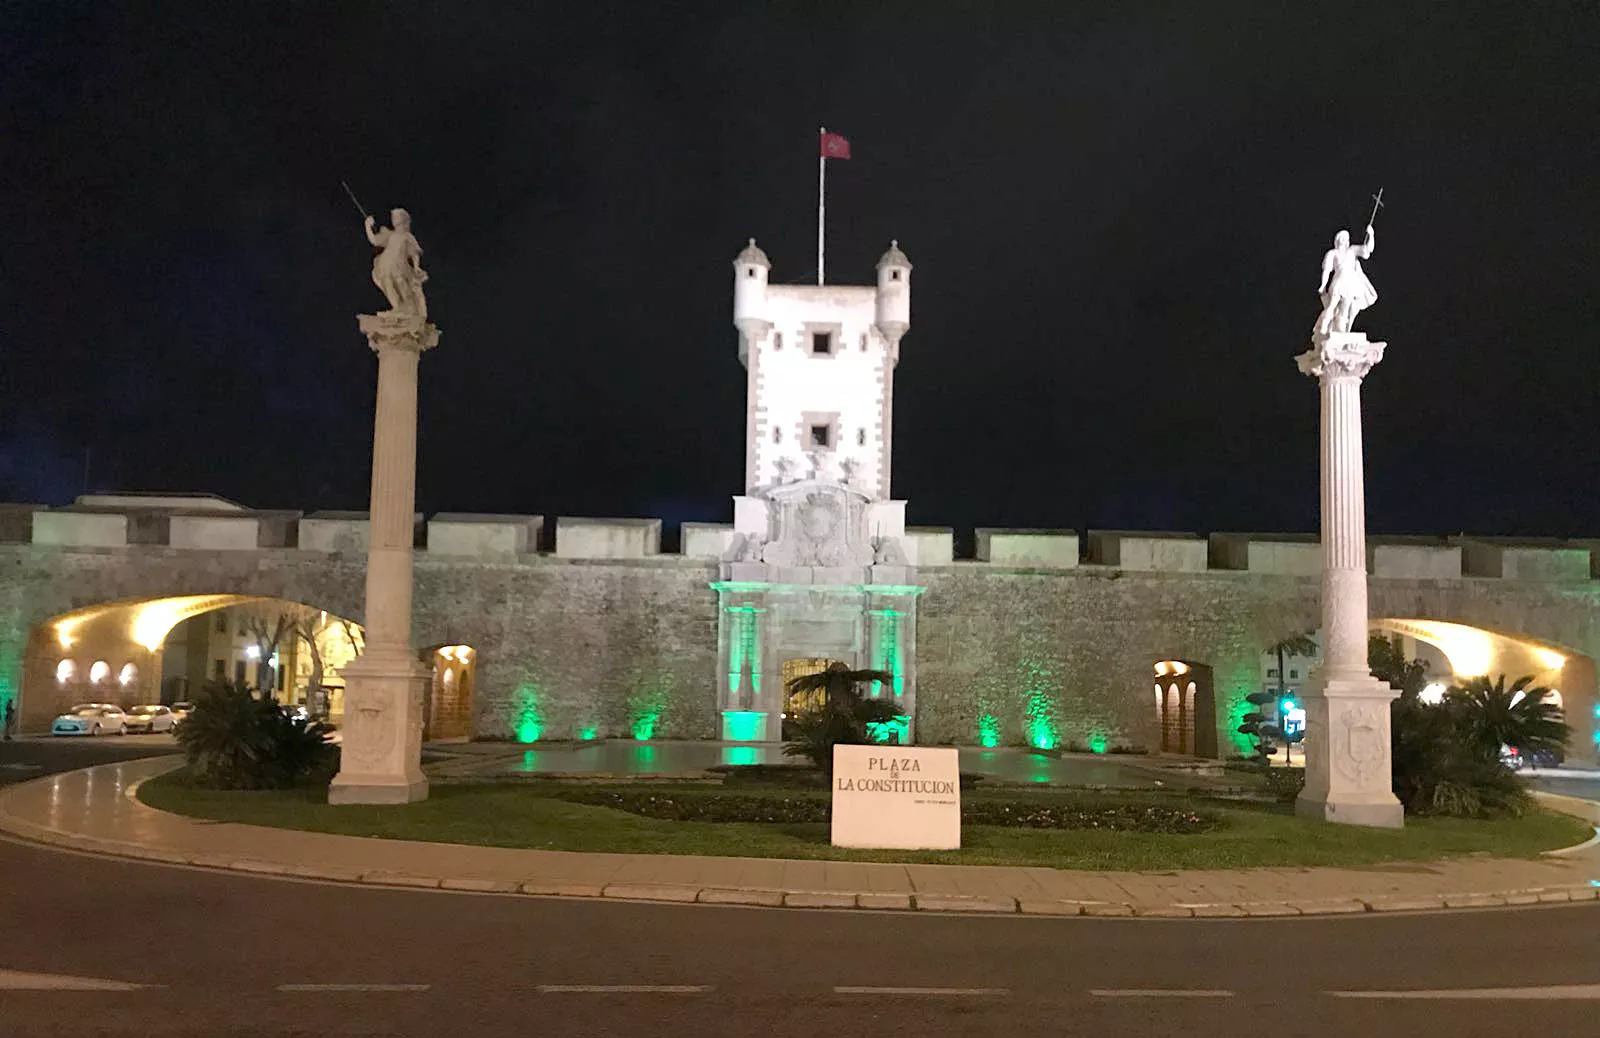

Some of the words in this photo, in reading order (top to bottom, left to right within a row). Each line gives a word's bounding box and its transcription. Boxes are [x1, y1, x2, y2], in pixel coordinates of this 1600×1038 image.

[868, 757, 920, 772] PLAZA
[838, 778, 854, 791] LA
[857, 779, 954, 794] CONSTITUCION
